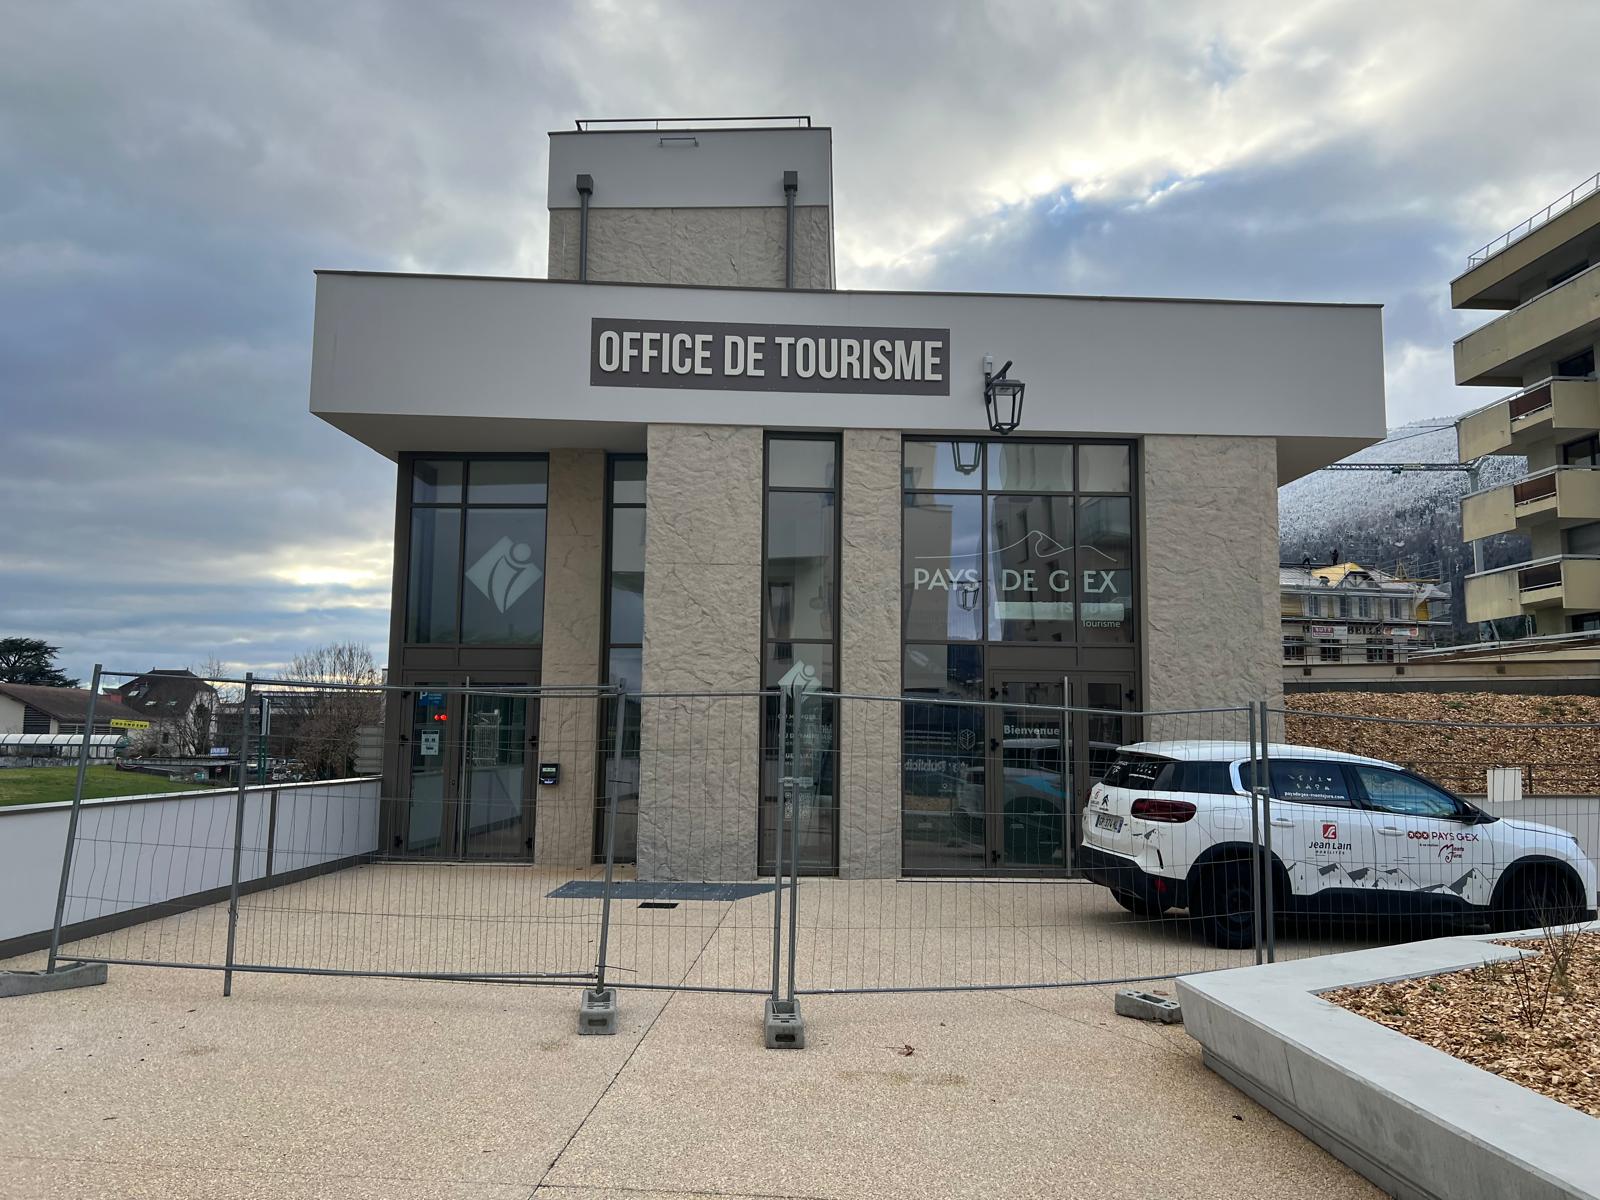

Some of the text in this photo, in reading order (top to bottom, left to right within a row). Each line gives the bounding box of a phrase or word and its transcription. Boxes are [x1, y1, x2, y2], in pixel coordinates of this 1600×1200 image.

[599, 330, 943, 381] OFFICE DE TOURISME
[914, 567, 979, 592] PAYS
[1002, 569, 1038, 592] DE
[1003, 725, 1060, 736] Bienvenue
[1431, 831, 1479, 842] PAYS GEX
[1309, 841, 1352, 851] Jean Lain
